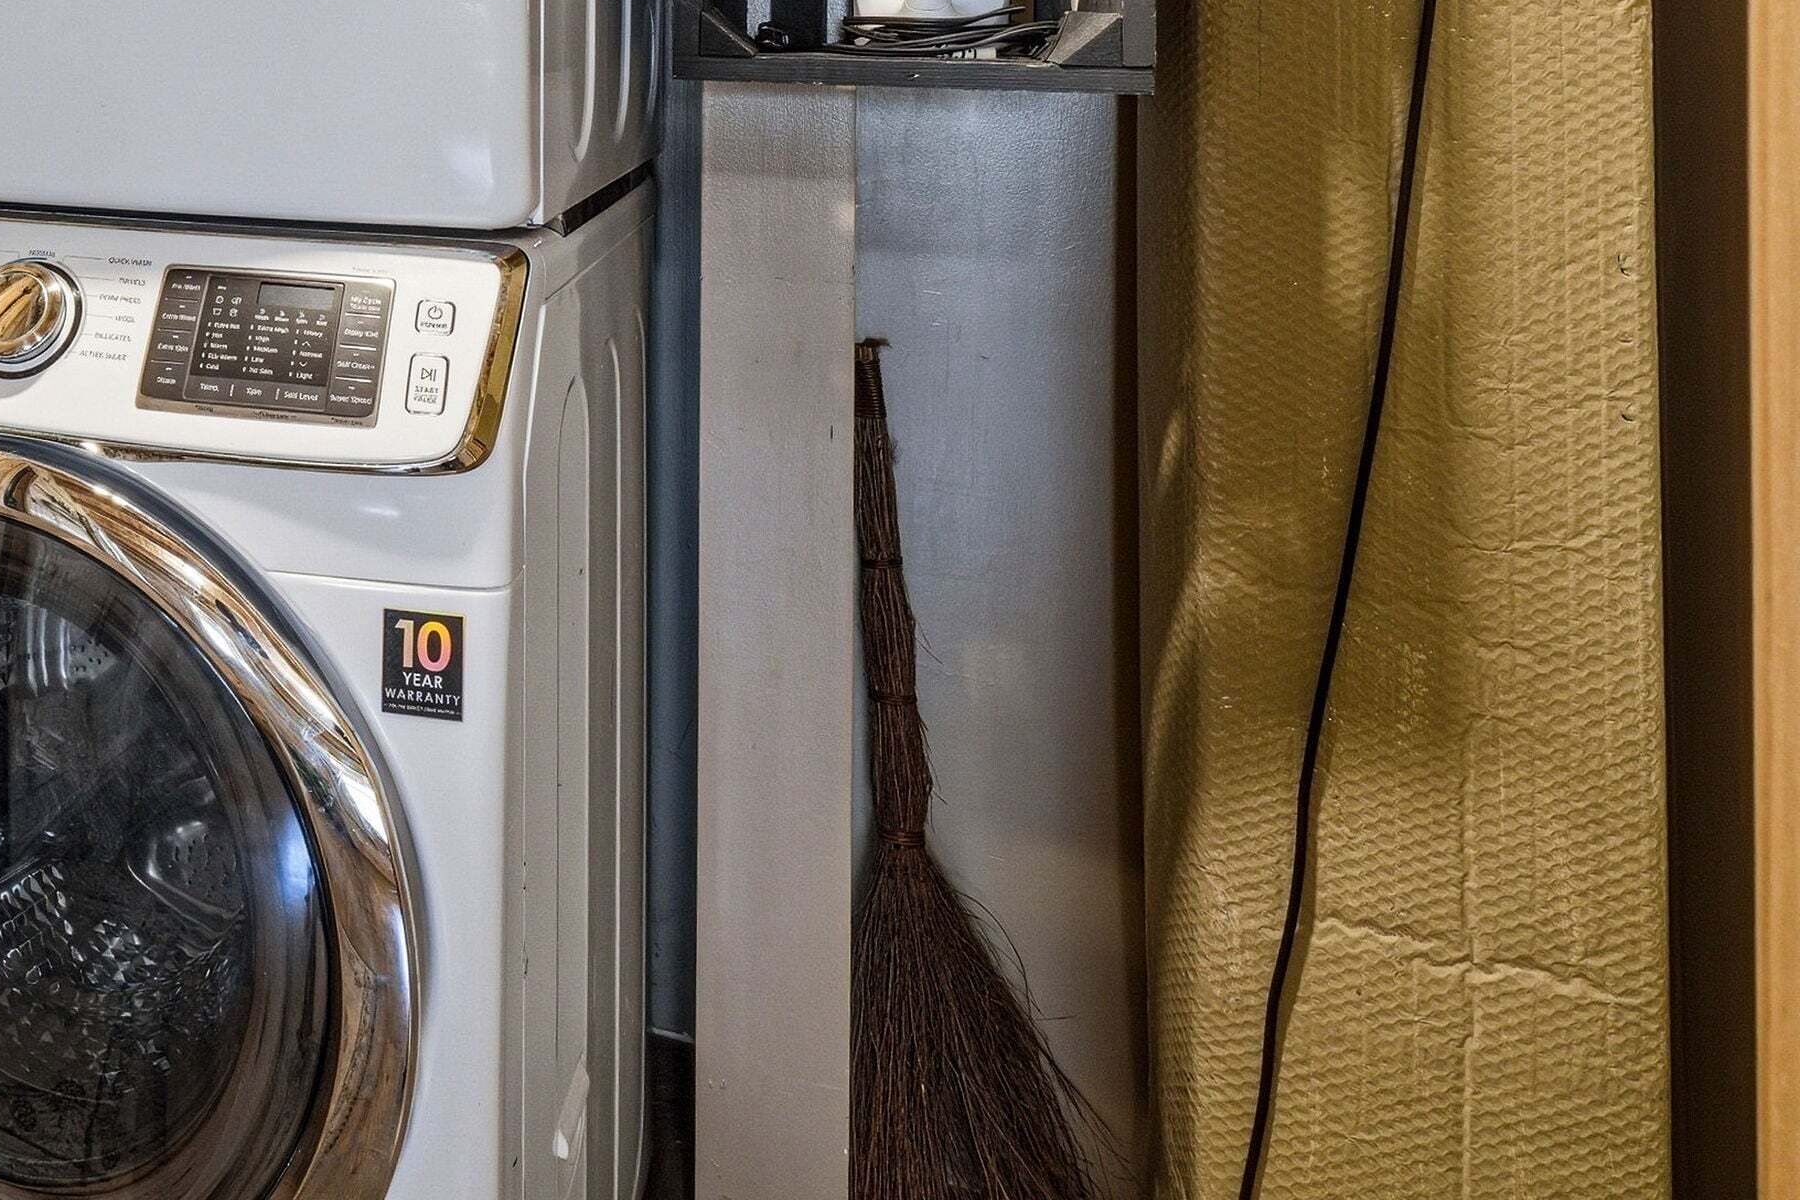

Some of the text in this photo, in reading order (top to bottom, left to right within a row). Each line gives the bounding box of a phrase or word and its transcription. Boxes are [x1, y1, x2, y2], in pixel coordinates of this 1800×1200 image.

[299, 392, 319, 401] Level
[394, 618, 452, 673] 10
[402, 671, 443, 689] YEAR
[384, 687, 461, 706] WARRANTY
